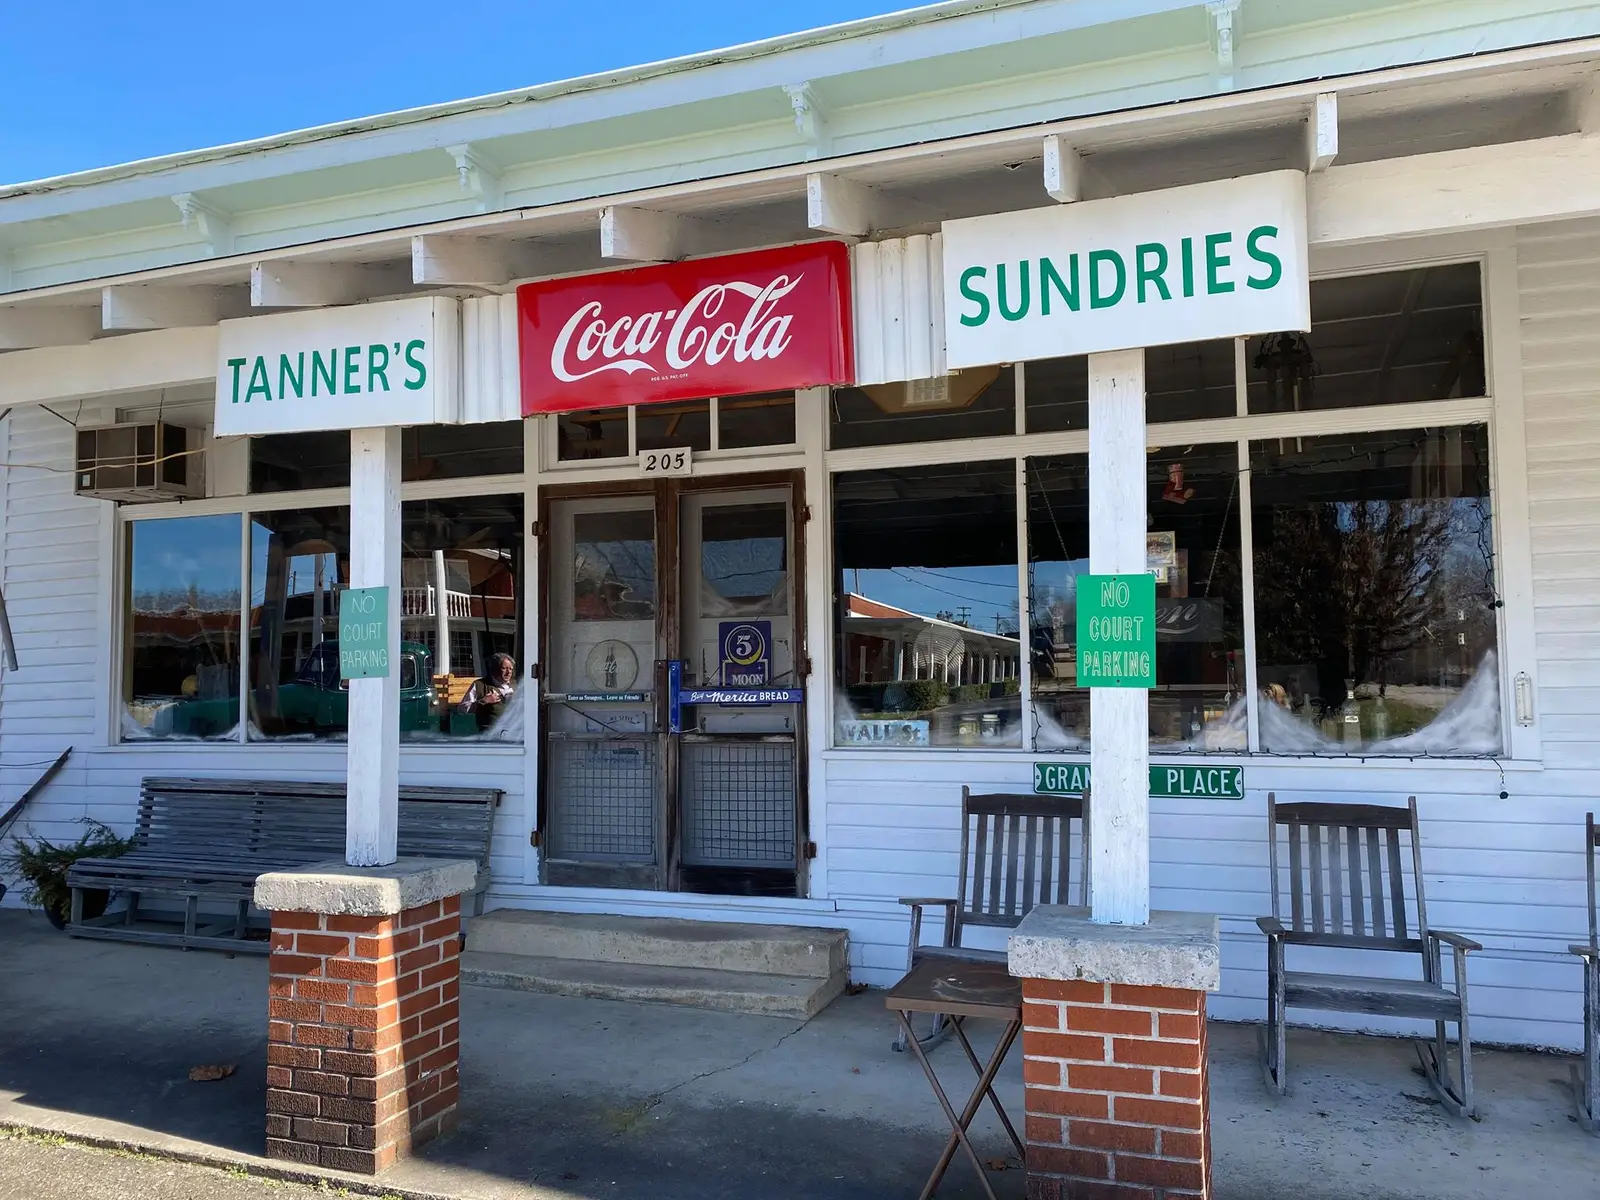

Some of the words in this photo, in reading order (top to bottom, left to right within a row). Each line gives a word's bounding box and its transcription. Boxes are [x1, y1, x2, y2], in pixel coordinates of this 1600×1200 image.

[959, 225, 1282, 327] SUNDRIES
[550, 272, 805, 382] Coca-Cola
[227, 339, 427, 404] TANNER'S
[645, 452, 685, 472] 205
[351, 595, 376, 614] NO
[1101, 581, 1130, 608] NO
[343, 622, 383, 642] COURT
[1089, 616, 1144, 642] COURT
[735, 635, 752, 656] 5
[341, 648, 388, 669] PARKING
[1083, 650, 1150, 678] PARKING
[732, 673, 764, 686] MOON
[706, 691, 758, 703] Merita
[759, 691, 789, 701] BREAD
[840, 724, 894, 741] WALL
[1166, 769, 1232, 795] PLACE
